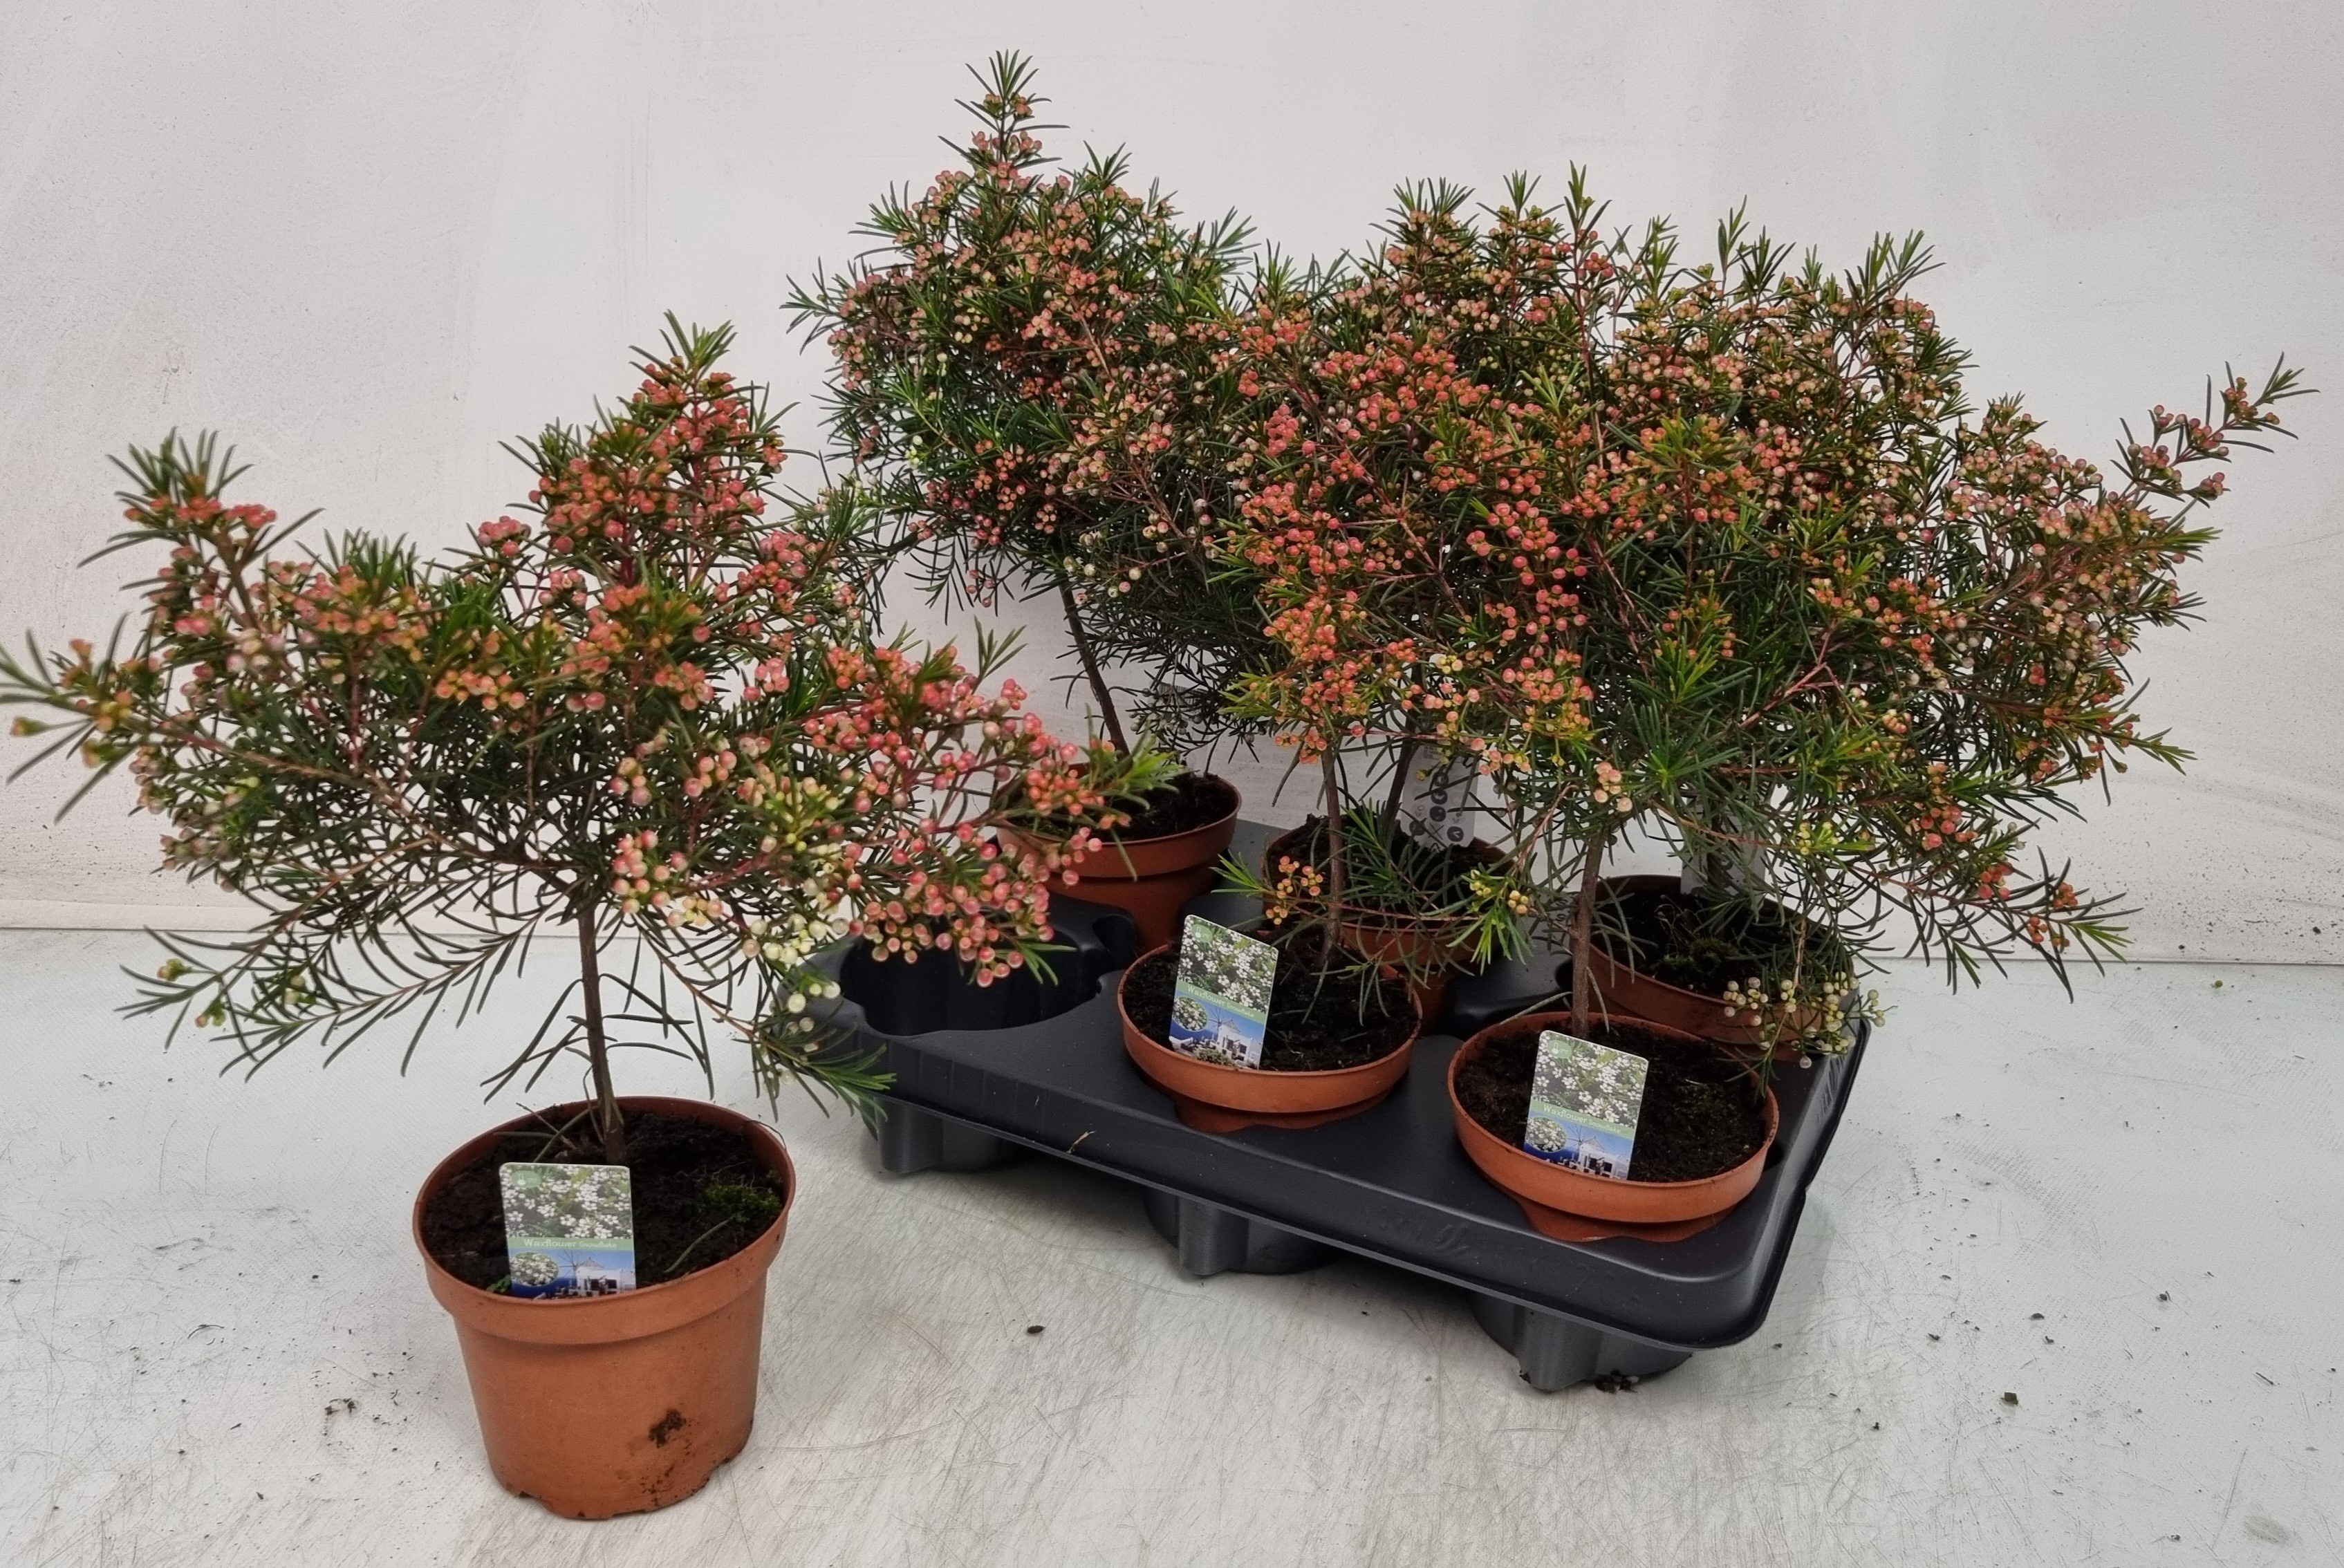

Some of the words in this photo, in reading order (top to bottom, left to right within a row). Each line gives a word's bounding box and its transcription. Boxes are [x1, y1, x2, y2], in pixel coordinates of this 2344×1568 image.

[1187, 984, 1226, 1007] Waxflower
[1543, 1103, 1588, 1123] Waxflower
[1588, 1119, 1621, 1134] Snowflake
[523, 1238, 577, 1249] Waxflower
